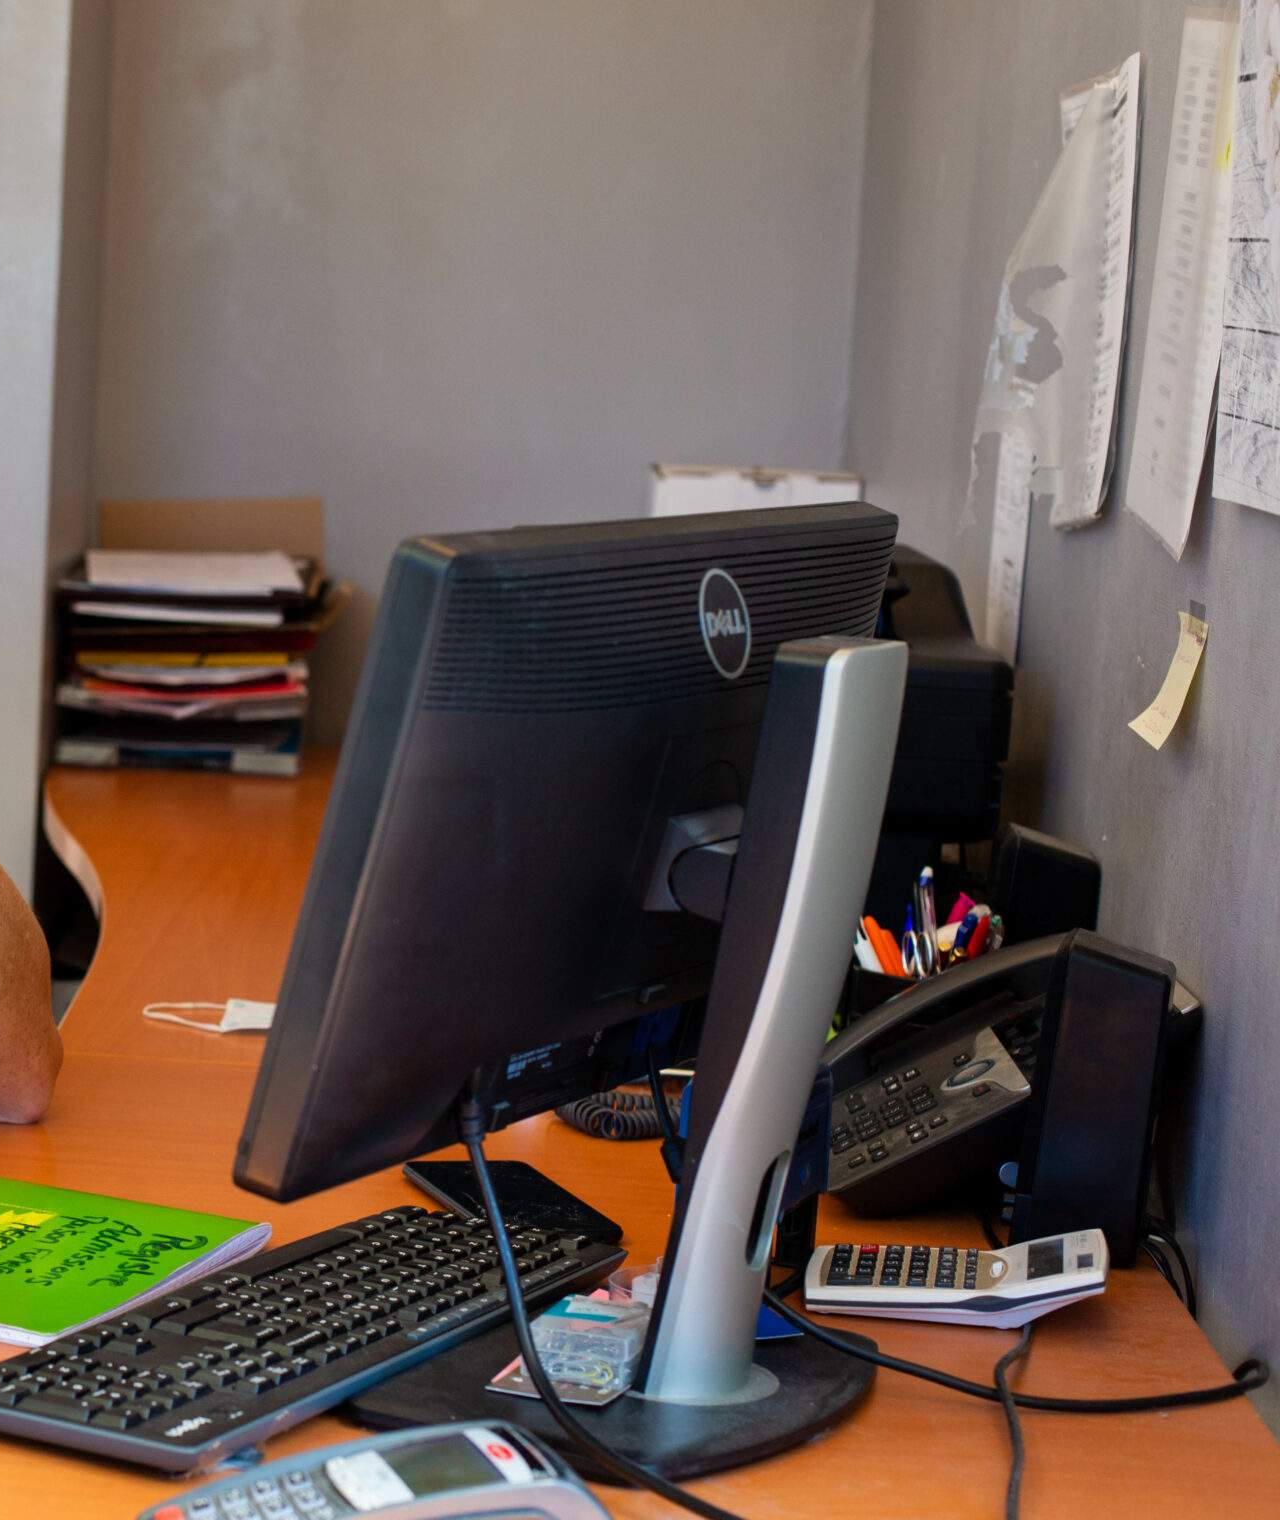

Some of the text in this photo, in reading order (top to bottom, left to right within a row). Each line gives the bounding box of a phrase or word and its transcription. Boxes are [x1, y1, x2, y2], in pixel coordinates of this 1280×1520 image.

[705, 609, 745, 637] DELL
[24, 1219, 142, 1286] Admissions
[87, 1233, 208, 1286] Registre
